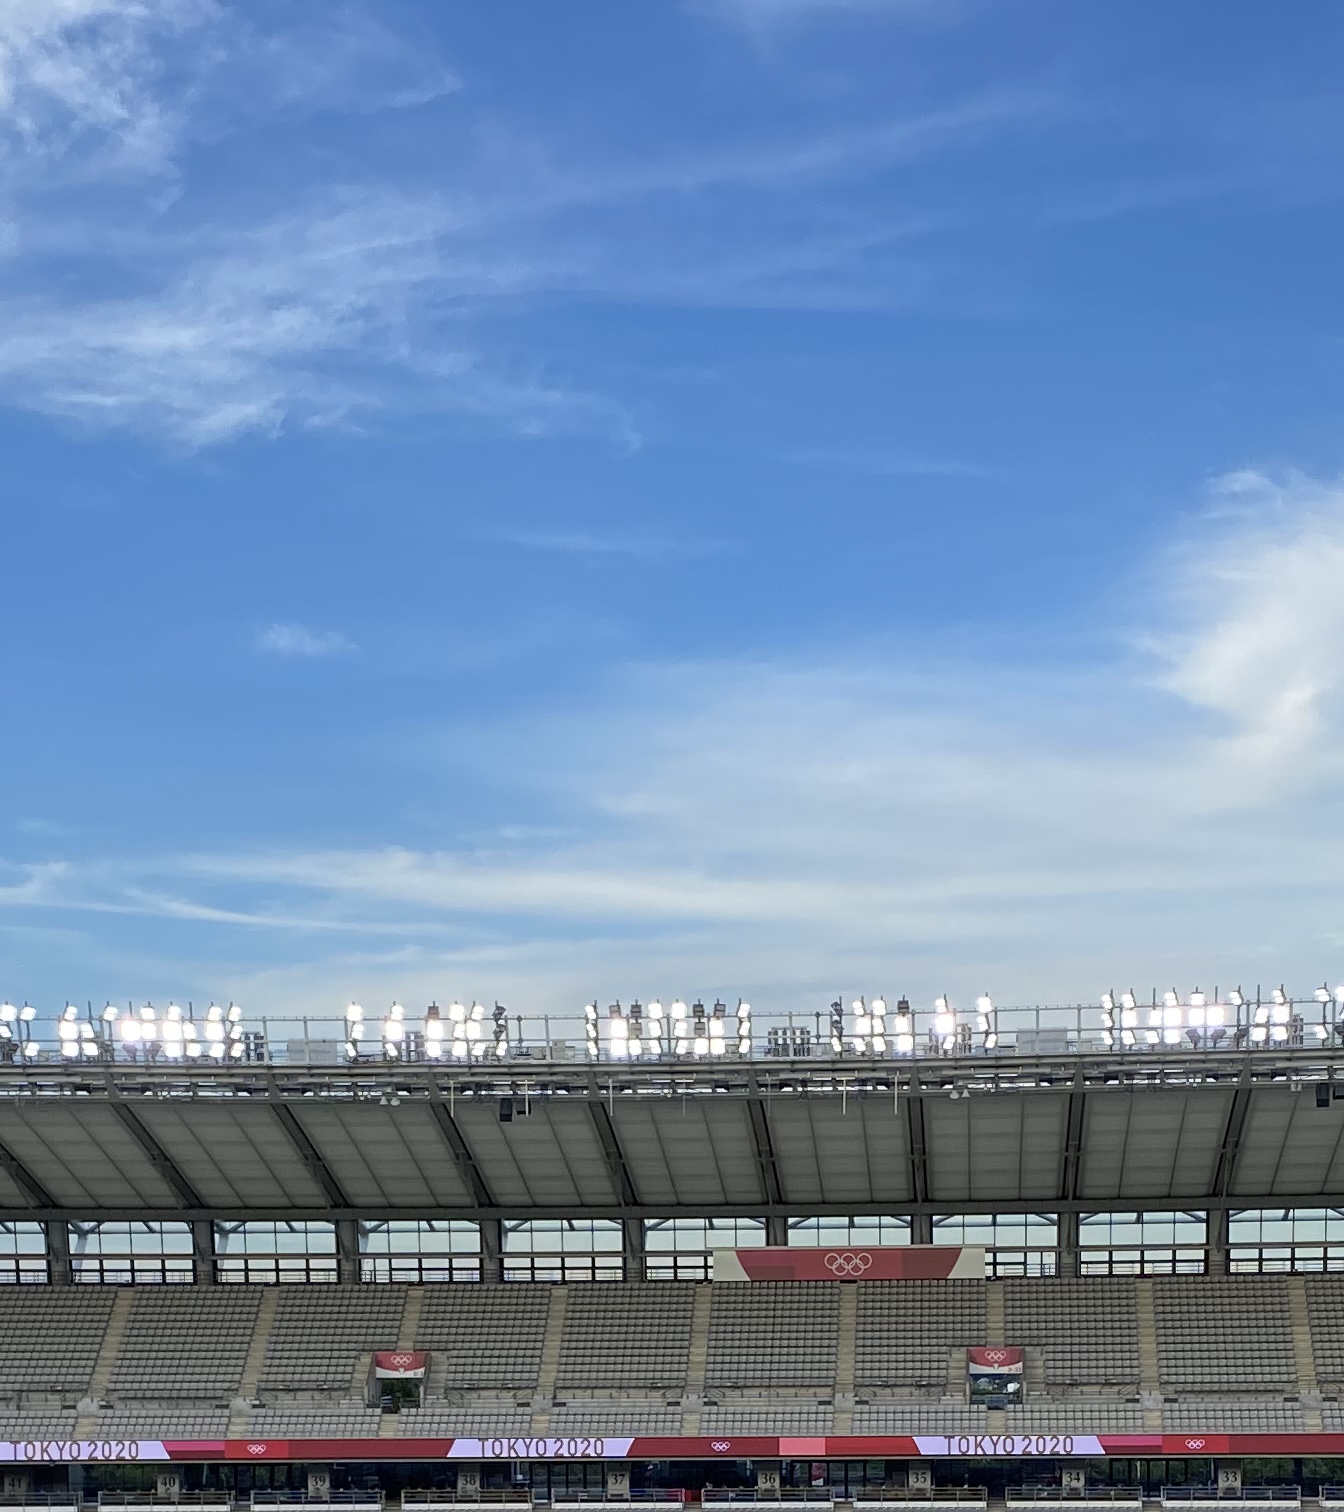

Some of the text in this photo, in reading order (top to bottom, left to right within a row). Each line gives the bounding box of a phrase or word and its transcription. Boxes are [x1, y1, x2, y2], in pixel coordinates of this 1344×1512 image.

[9, 1440, 139, 1460] TOKYO 2020
[478, 1438, 604, 1457] TOKYO 2020
[943, 1436, 1074, 1454] TOKYO 2020
[160, 1476, 175, 1487] 40
[311, 1475, 326, 1486] 39
[461, 1474, 476, 1486] 38
[611, 1473, 626, 1485] 37
[761, 1472, 776, 1484] 36
[912, 1472, 927, 1483] 35
[1066, 1471, 1081, 1483] 34
[1223, 1471, 1238, 1482] 33
